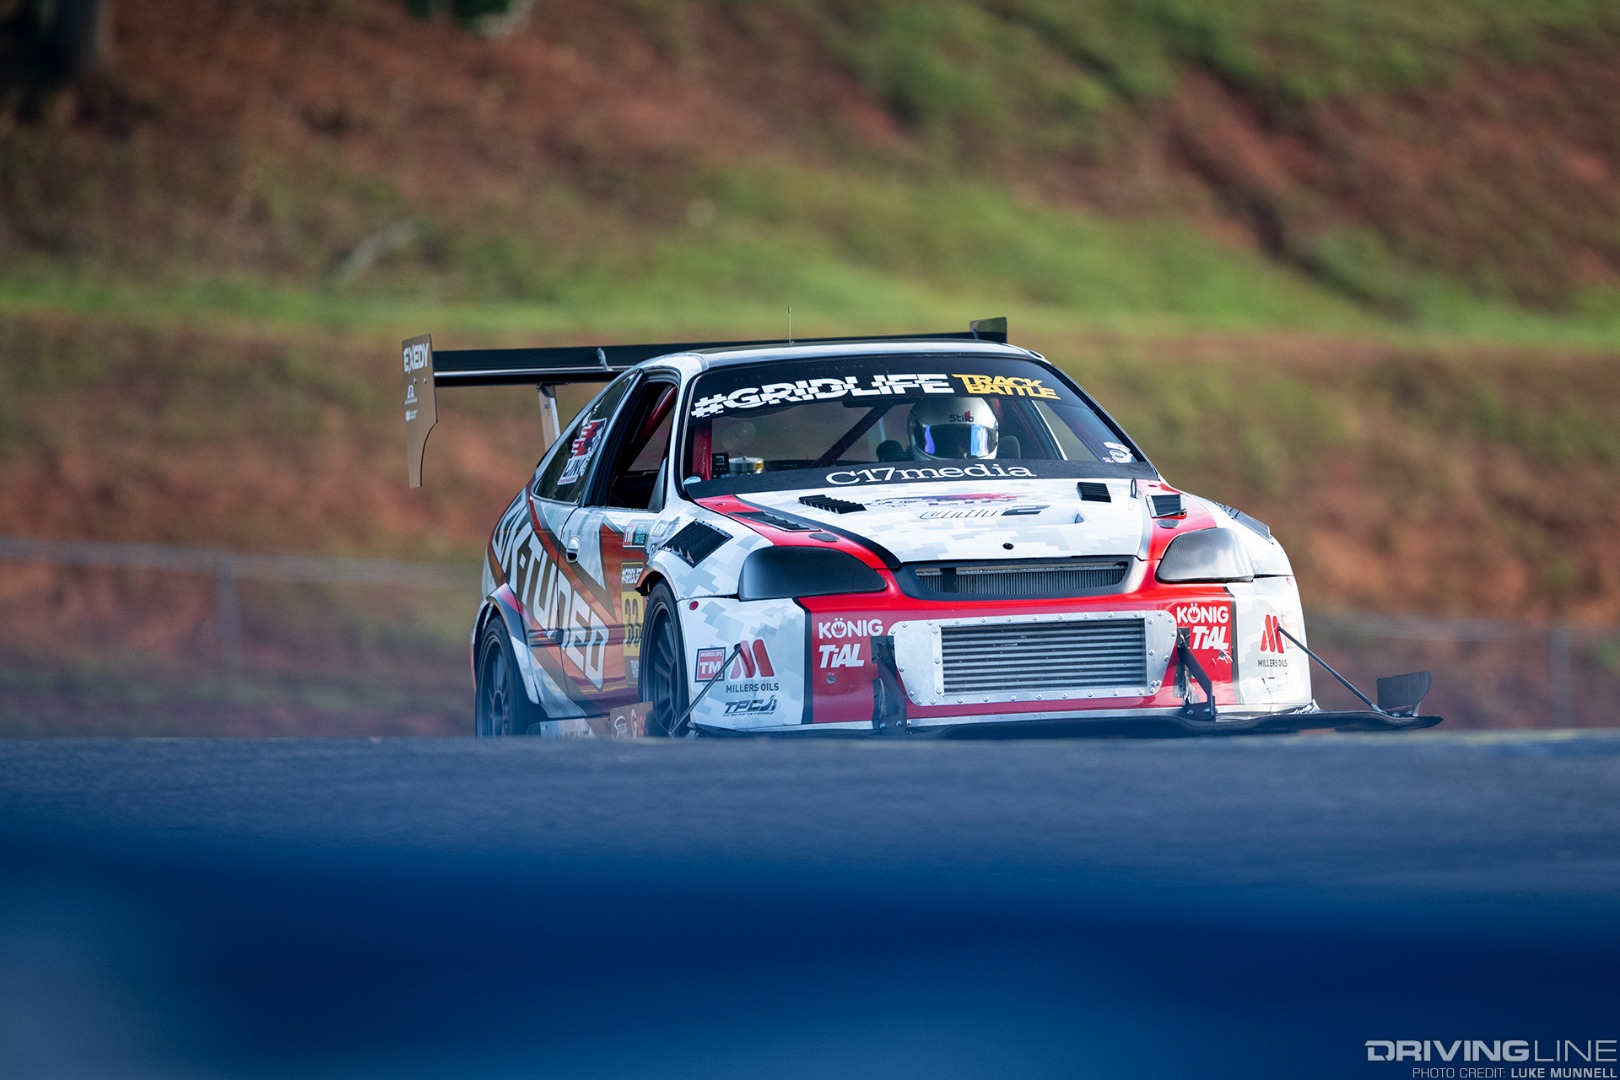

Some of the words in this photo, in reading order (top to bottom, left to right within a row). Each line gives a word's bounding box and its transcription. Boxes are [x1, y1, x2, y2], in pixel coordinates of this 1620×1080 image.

[403, 342, 429, 374] EXEDY
[951, 374, 1043, 390] TRACK
[691, 373, 954, 418] #GRIDLIFE
[971, 385, 1061, 400] BATTLE
[949, 409, 975, 422] Stilo
[826, 465, 1037, 485] C17media
[1176, 603, 1229, 624] KÖNIG
[818, 617, 883, 639] KÖNIG
[699, 661, 722, 675] TM
[725, 684, 759, 694] MILLERS
[761, 682, 779, 692] OILS
